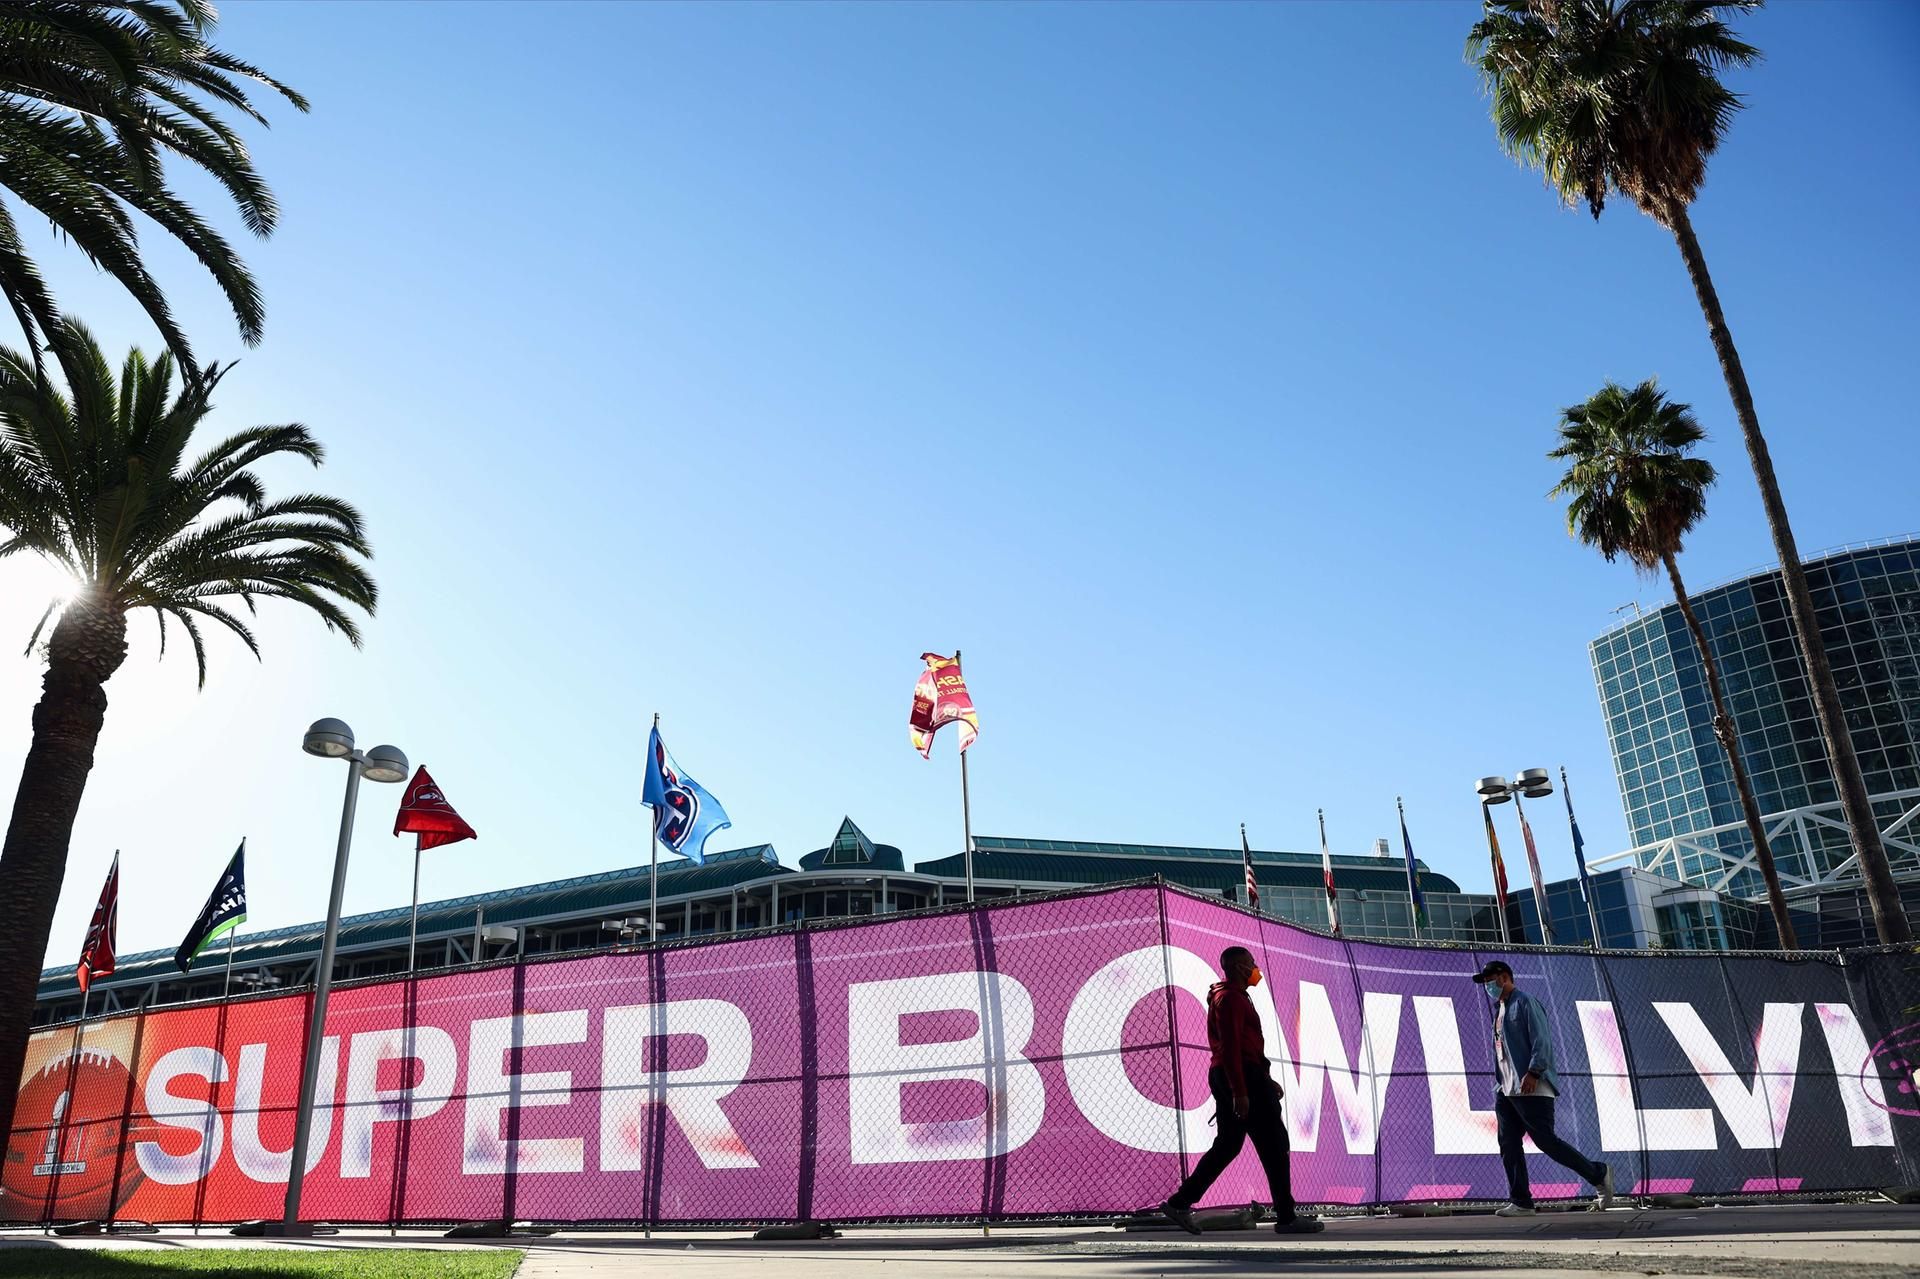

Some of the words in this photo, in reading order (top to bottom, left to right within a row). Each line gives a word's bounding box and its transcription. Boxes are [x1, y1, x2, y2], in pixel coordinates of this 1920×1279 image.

[135, 998, 760, 1186] SUPER
[848, 944, 1545, 1165] BOWL
[1575, 1000, 1895, 1151] LVI
